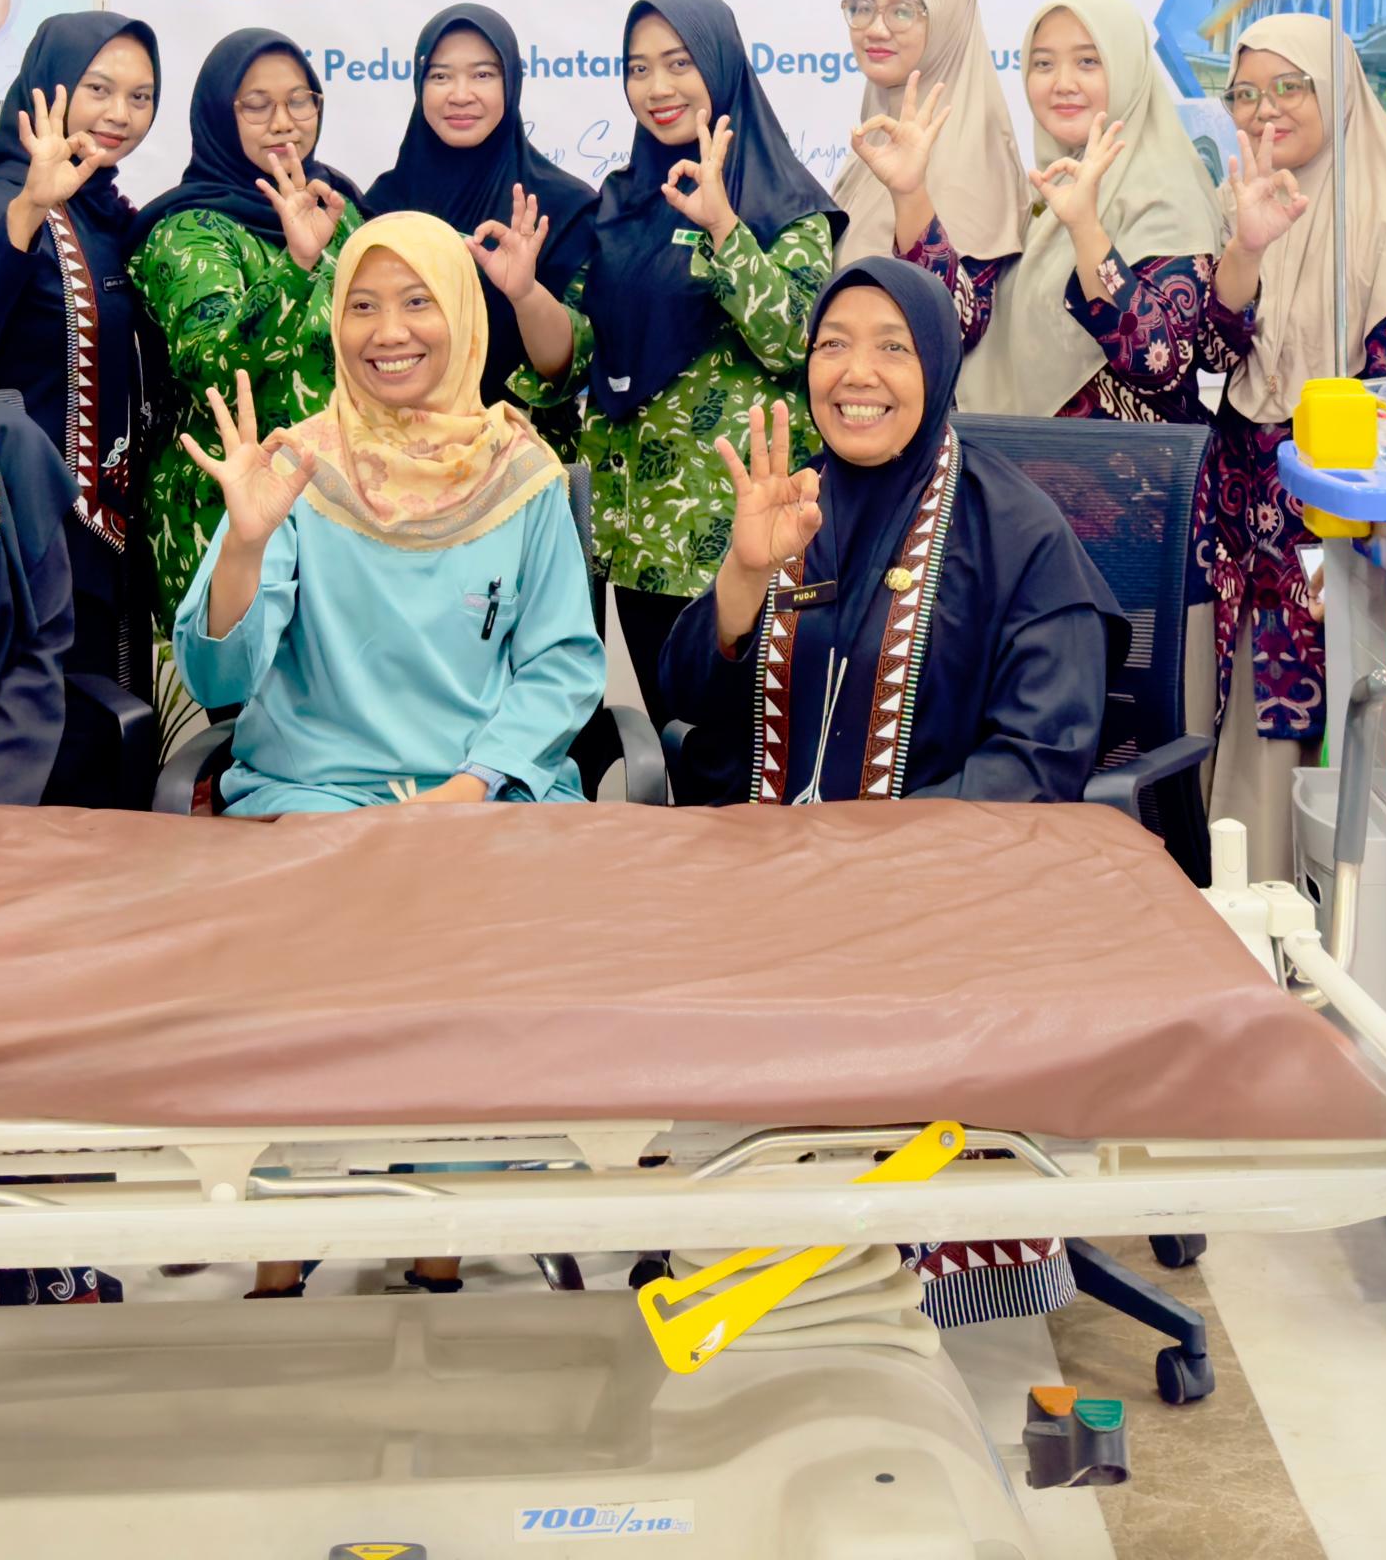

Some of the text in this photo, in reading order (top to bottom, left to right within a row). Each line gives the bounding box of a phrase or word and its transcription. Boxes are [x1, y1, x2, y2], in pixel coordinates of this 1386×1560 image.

[324, 47, 412, 82] Pedu
[751, 42, 861, 83] Denga
[793, 590, 817, 602] PUDJI
